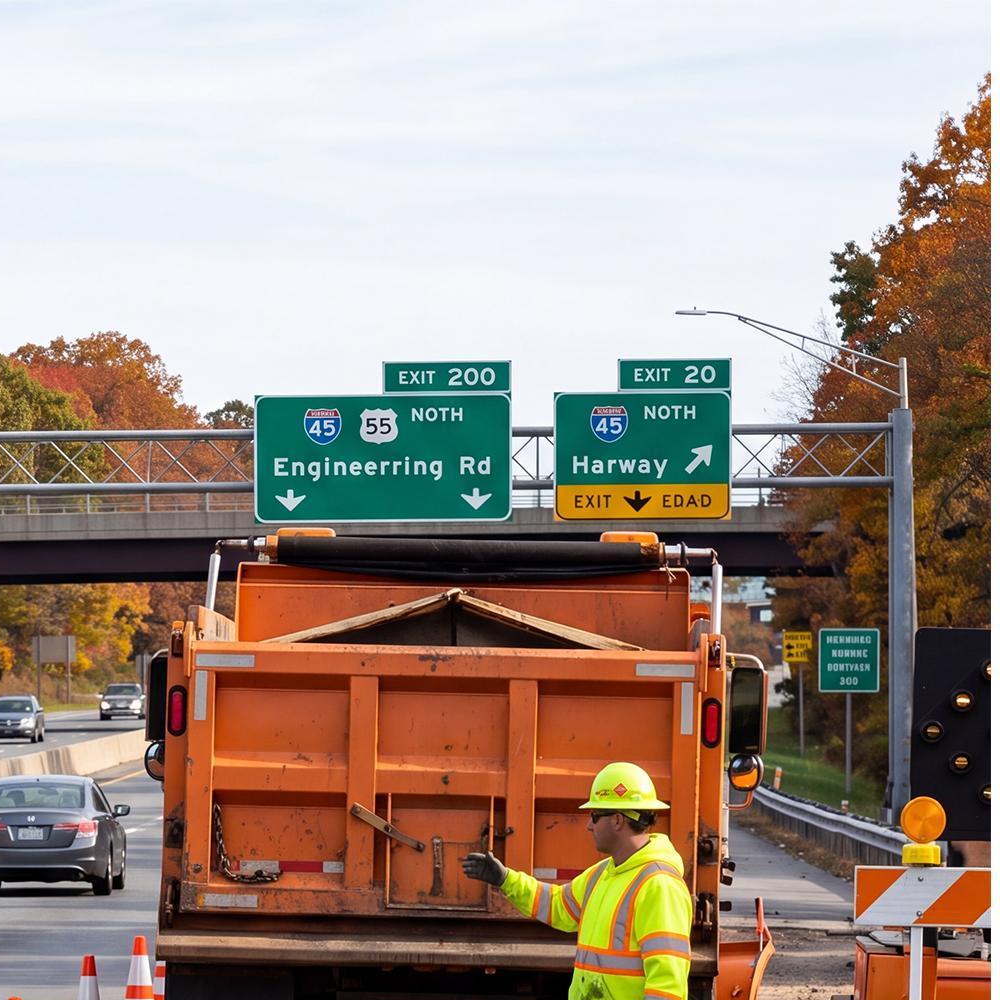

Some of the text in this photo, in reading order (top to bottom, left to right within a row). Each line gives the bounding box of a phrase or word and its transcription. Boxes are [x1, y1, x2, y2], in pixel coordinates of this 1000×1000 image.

[398, 367, 496, 386] EXIT 200
[634, 365, 716, 384] EXIT 20
[309, 407, 463, 437] 45 55 NOTH
[595, 405, 696, 435] 45 NOTH
[273, 456, 491, 482] Engineerring Rd
[572, 455, 668, 480] Harway
[574, 494, 712, 508] EXIT EDAD
